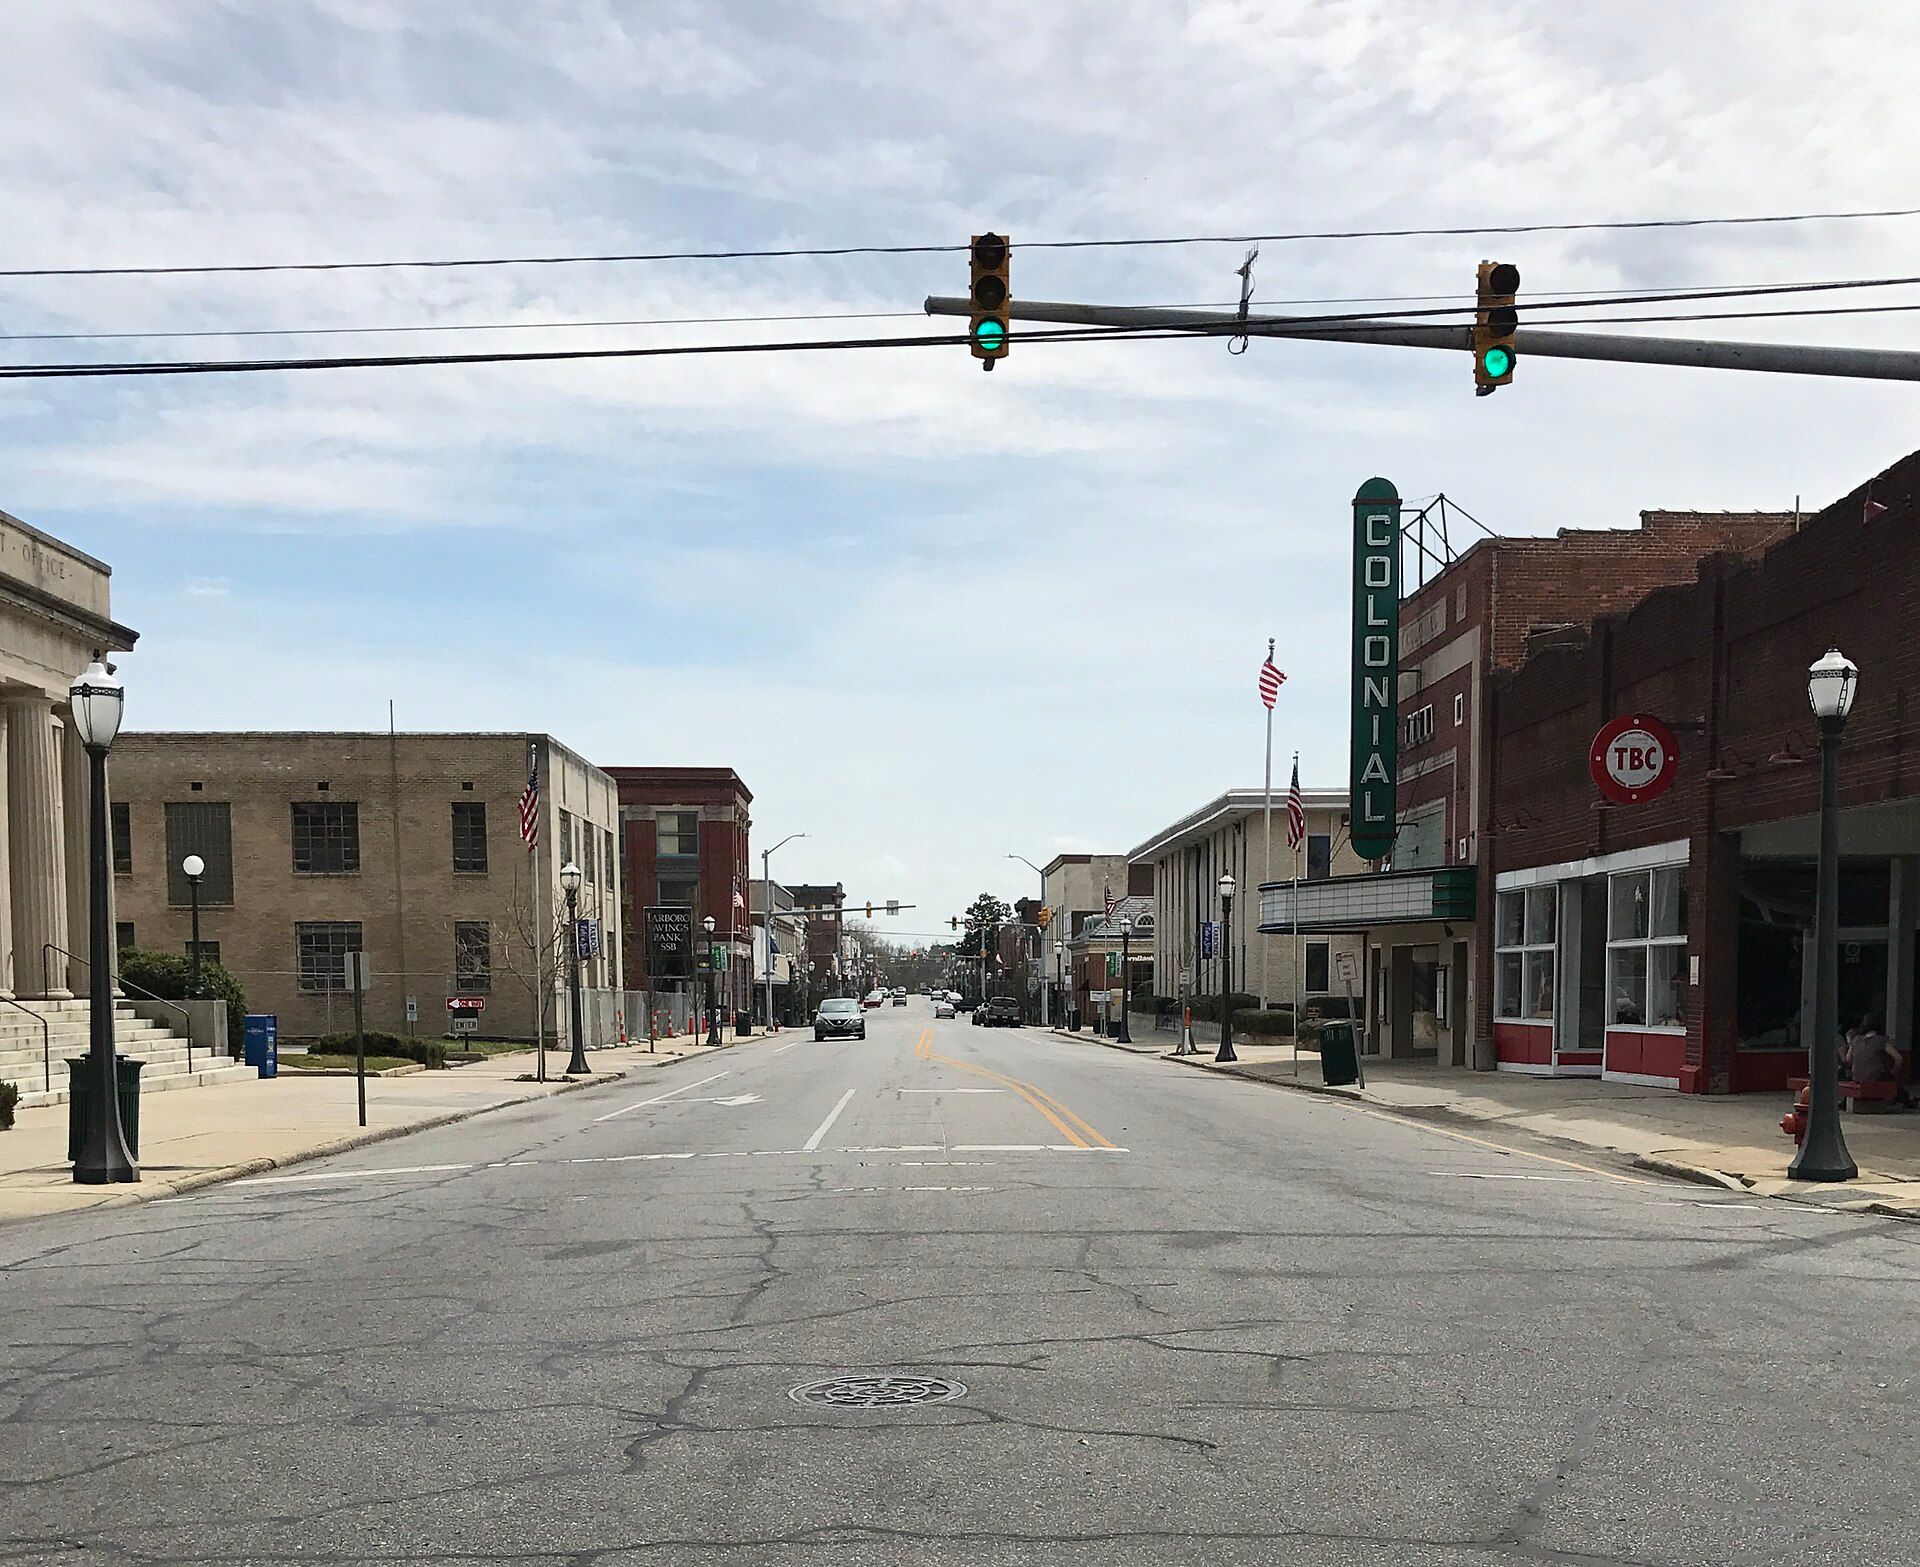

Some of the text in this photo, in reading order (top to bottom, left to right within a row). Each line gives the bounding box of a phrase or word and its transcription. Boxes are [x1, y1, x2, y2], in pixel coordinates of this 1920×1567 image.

[22, 544, 65, 580] OFFICE
[1360, 514, 1391, 821] COLONIAL
[1614, 746, 1657, 771] TBC
[590, 923, 598, 956] TARBORO
[652, 923, 689, 932] AVINGS
[653, 933, 684, 942] BANK
[660, 942, 677, 951] SSB
